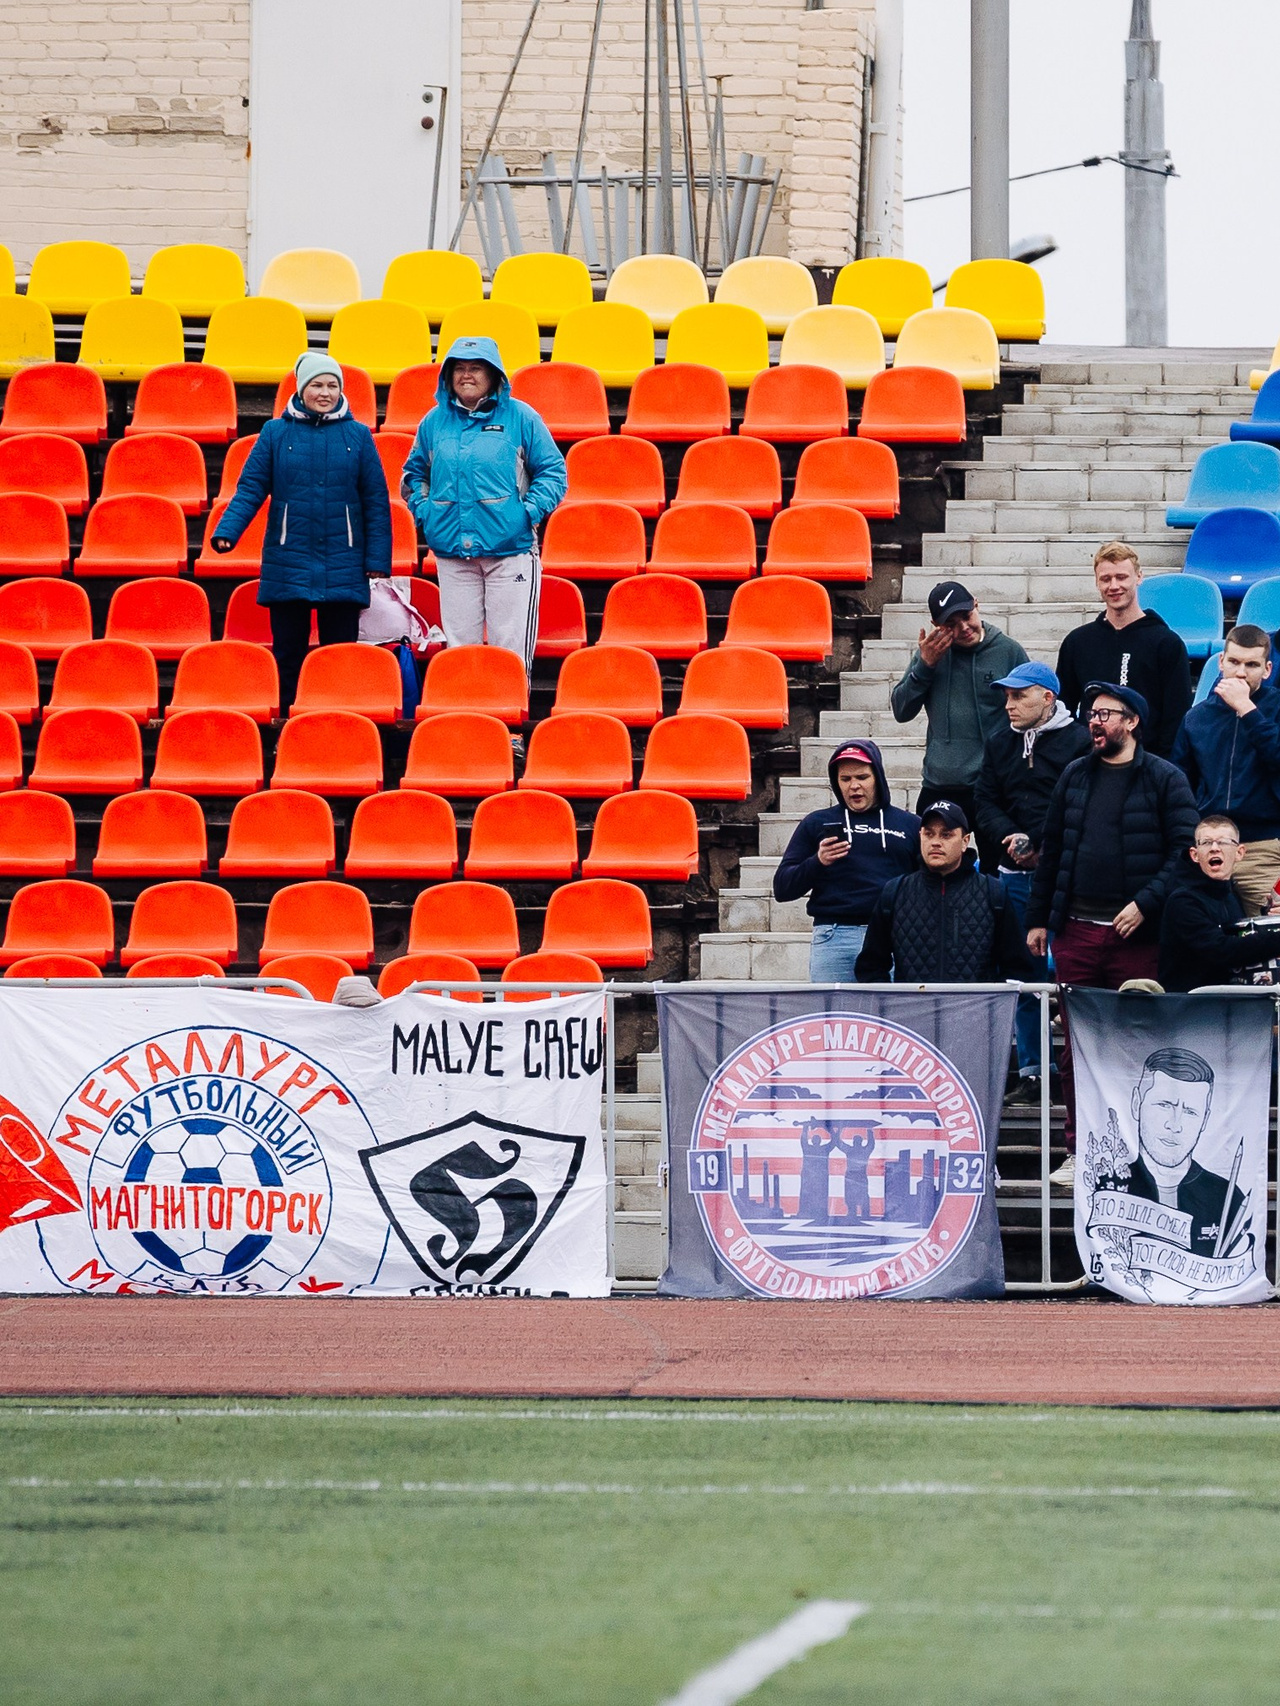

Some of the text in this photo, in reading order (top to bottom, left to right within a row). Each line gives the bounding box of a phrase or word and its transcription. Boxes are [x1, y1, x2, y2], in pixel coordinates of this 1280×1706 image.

[1119, 652, 1131, 686] Reebok
[391, 1016, 603, 1081] MALYE CREW
[55, 1031, 351, 1156] МЕТАЛЛУРГ
[702, 1023, 976, 1145] МЕТАЛЛУРГ-МАГНИТОГОРСК
[113, 1079, 319, 1172] ФУТБОЛЬНЫЙ
[695, 1154, 719, 1187] 19
[952, 1156, 984, 1190] 32
[90, 1184, 324, 1235] МАГНИТОГОРСК
[1093, 1197, 1116, 1217] КТО
[1117, 1200, 1126, 1219] В
[1126, 1203, 1156, 1226] ДЕЛЕ
[1135, 1242, 1157, 1264] ТОТ
[1157, 1248, 1187, 1275] СЛОВ
[1186, 1260, 1205, 1280] НЕ
